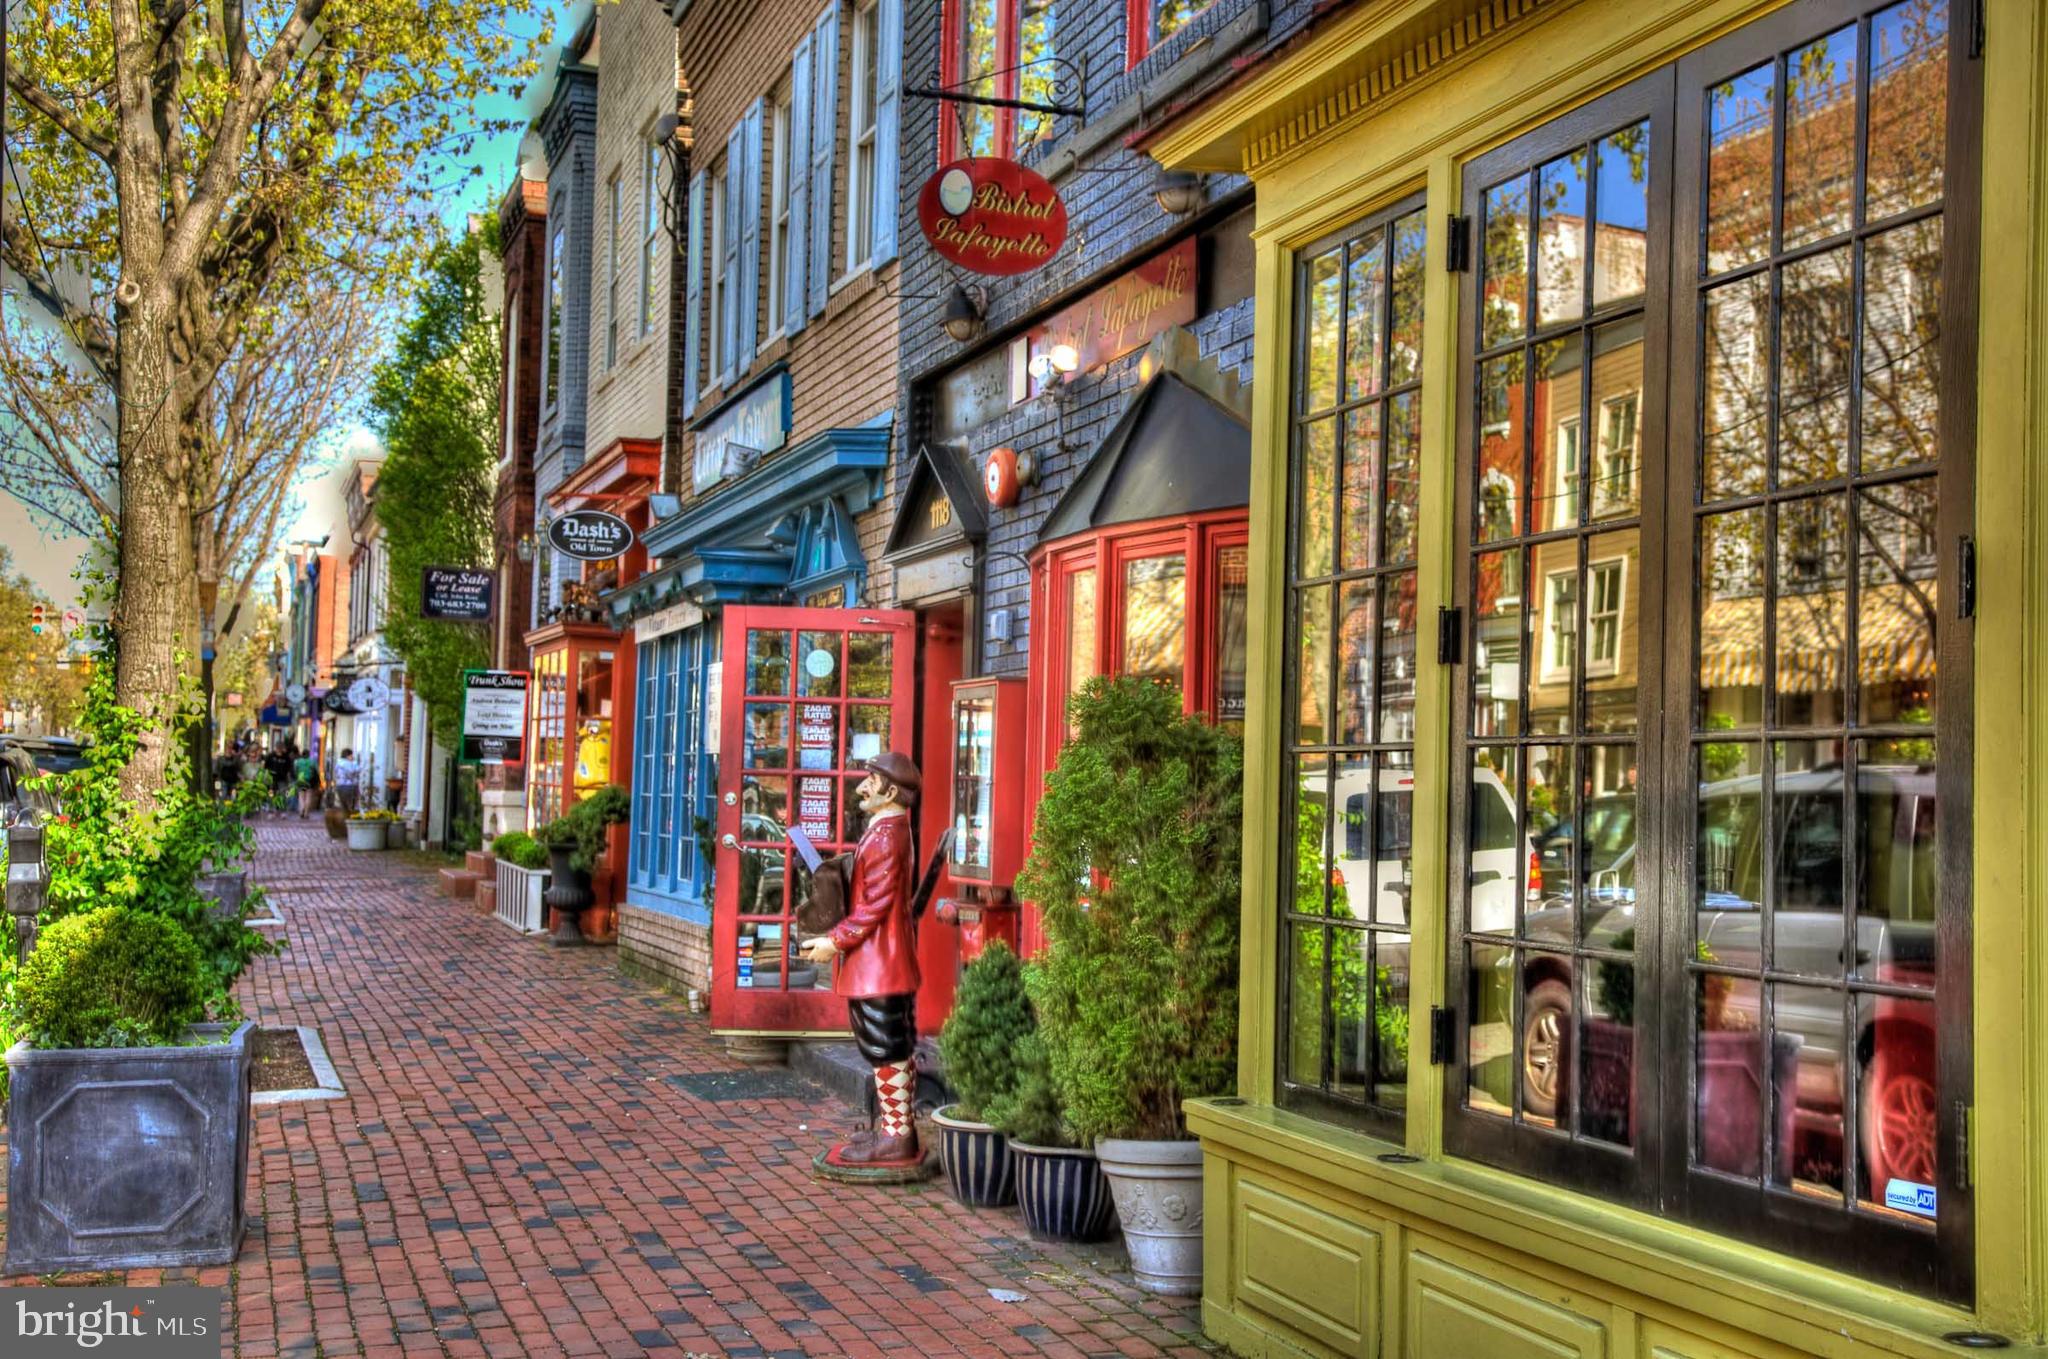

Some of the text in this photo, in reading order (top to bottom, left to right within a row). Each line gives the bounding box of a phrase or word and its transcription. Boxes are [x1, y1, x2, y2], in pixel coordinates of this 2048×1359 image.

[973, 182, 1057, 220] Bistrot
[933, 217, 1050, 258] Lafayette
[1099, 254, 1189, 351] Lafayette
[929, 496, 950, 529] 1118
[562, 517, 621, 539] Dash's
[570, 543, 613, 553] Old Town
[430, 571, 489, 585] For Sale
[436, 583, 481, 593] or Lease
[469, 675, 525, 687] Trunk Show
[803, 704, 832, 712] ZAGAT
[803, 712, 832, 720] RATED
[801, 726, 831, 734] ZAGAT
[802, 734, 831, 742] RATED
[801, 776, 831, 785] ZAGAT
[801, 784, 831, 792] RATED
[800, 799, 829, 807] ZAGAT
[801, 806, 829, 815] RATED
[1888, 1193, 1909, 1202] secured
[1918, 1191, 1934, 1208] ADT
